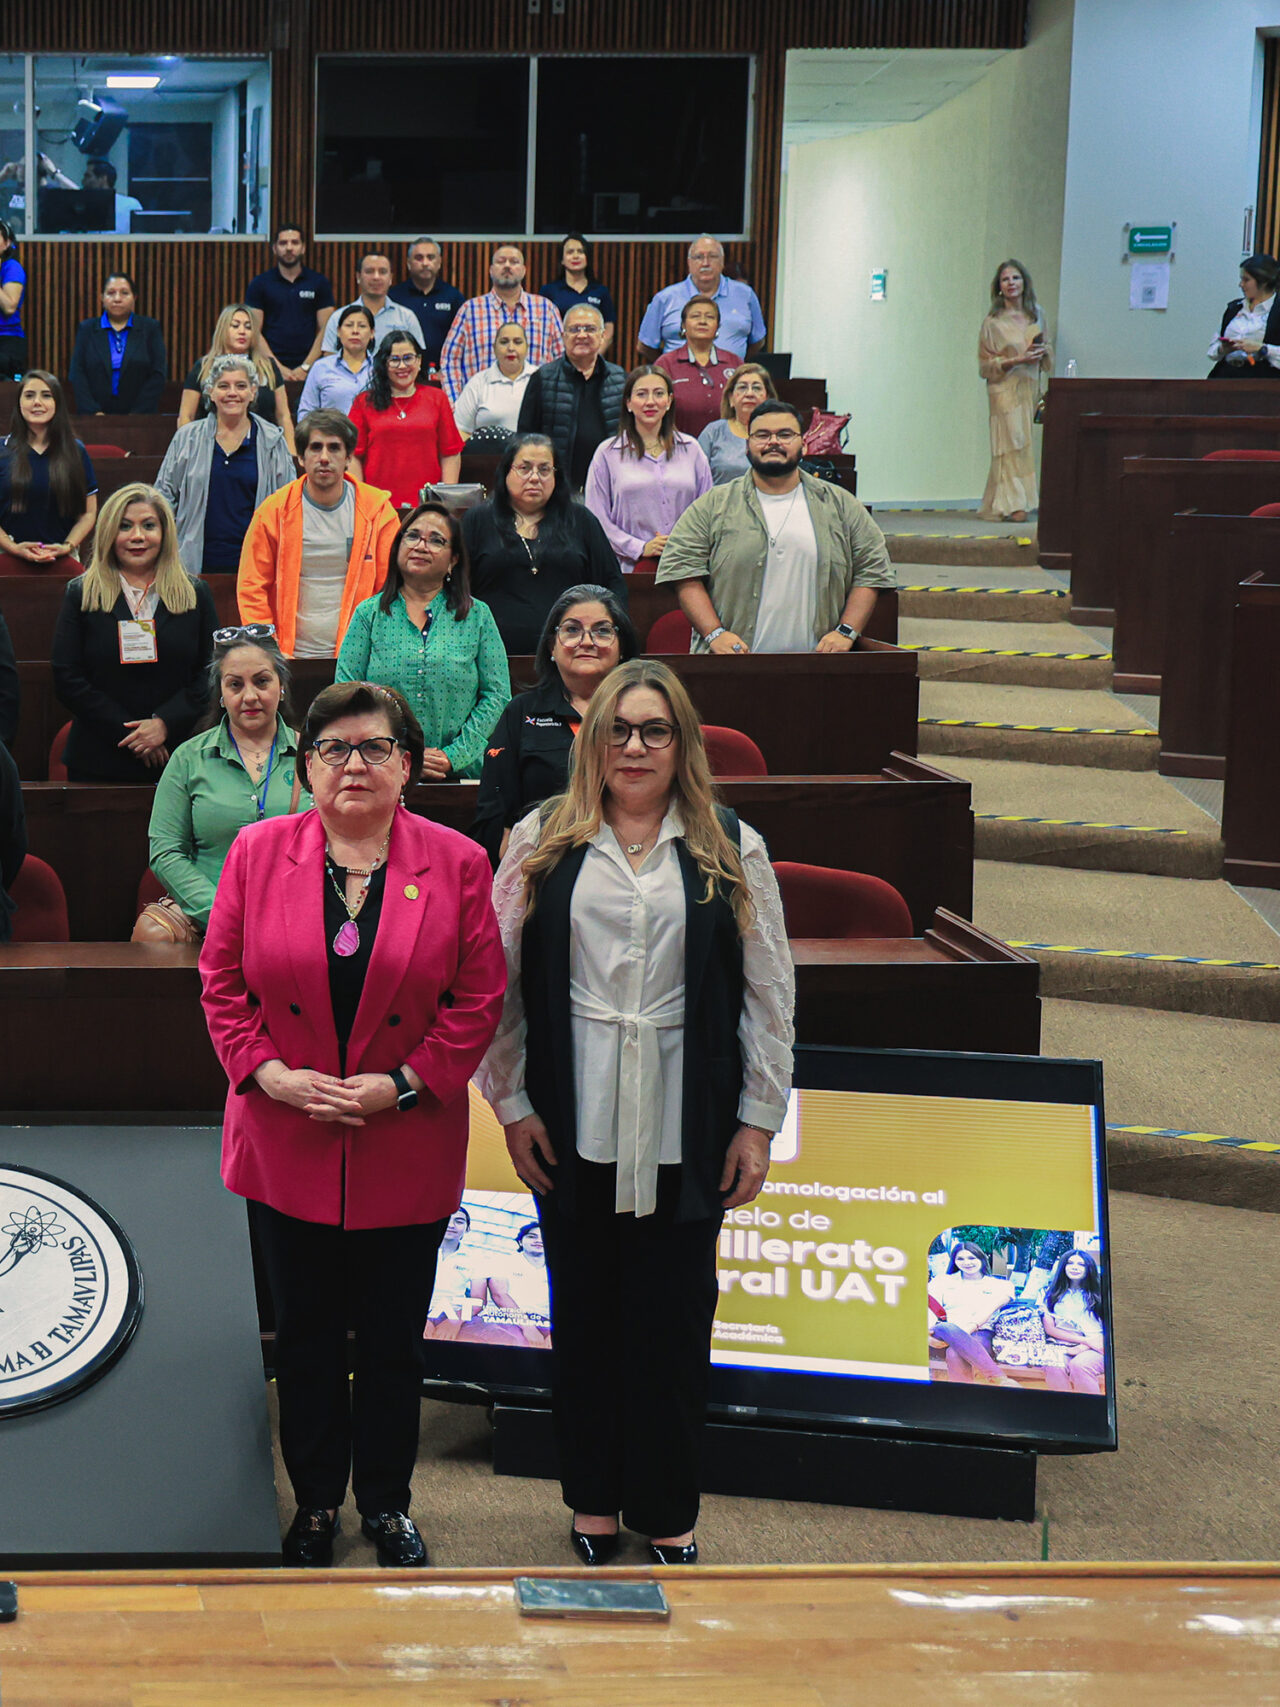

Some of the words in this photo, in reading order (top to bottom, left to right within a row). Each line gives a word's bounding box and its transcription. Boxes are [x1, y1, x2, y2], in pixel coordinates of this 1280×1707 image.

[922, 1190, 944, 1205] al
[788, 1210, 831, 1231] de
[801, 1269, 907, 1305] UAT
